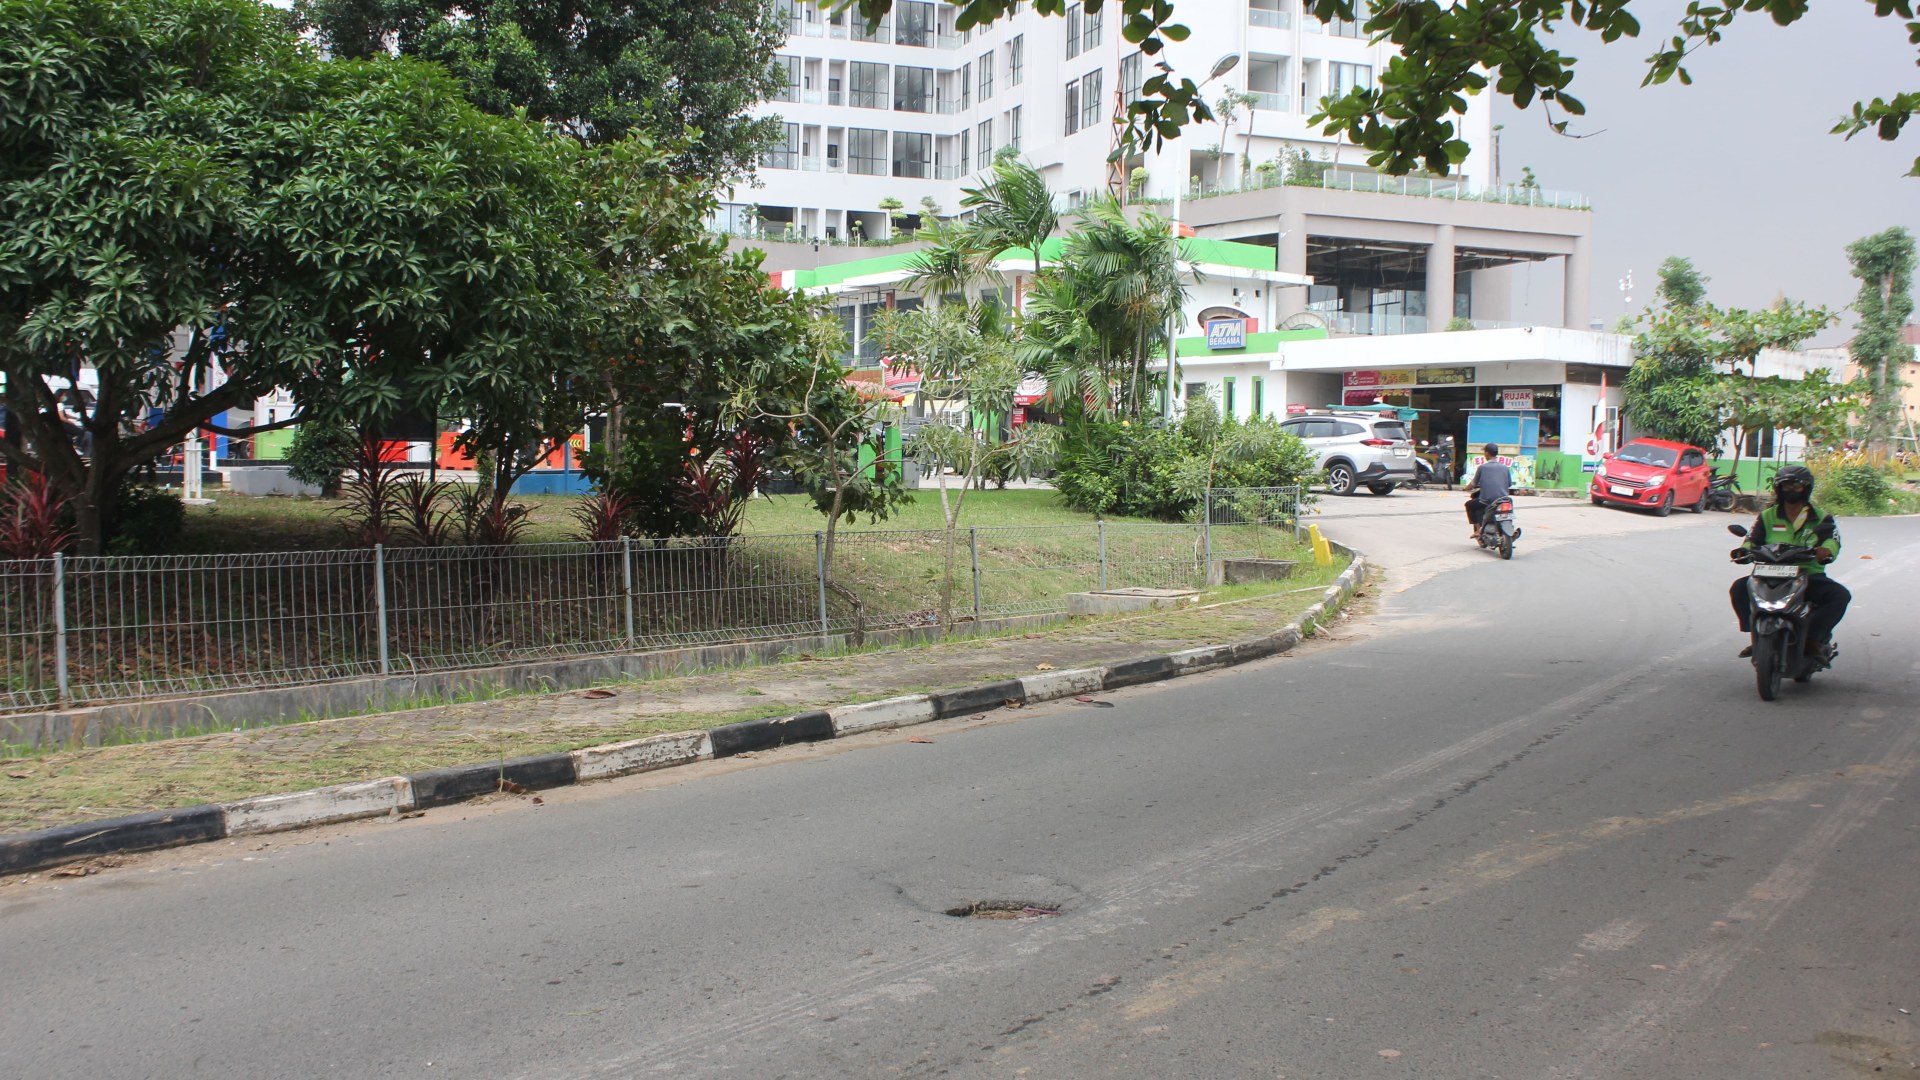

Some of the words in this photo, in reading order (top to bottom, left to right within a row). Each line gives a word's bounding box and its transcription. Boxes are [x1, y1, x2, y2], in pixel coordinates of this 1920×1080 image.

[1210, 322, 1241, 338] ATM
[1209, 337, 1241, 346] BERSAMA
[1504, 392, 1531, 401] RUJAK
